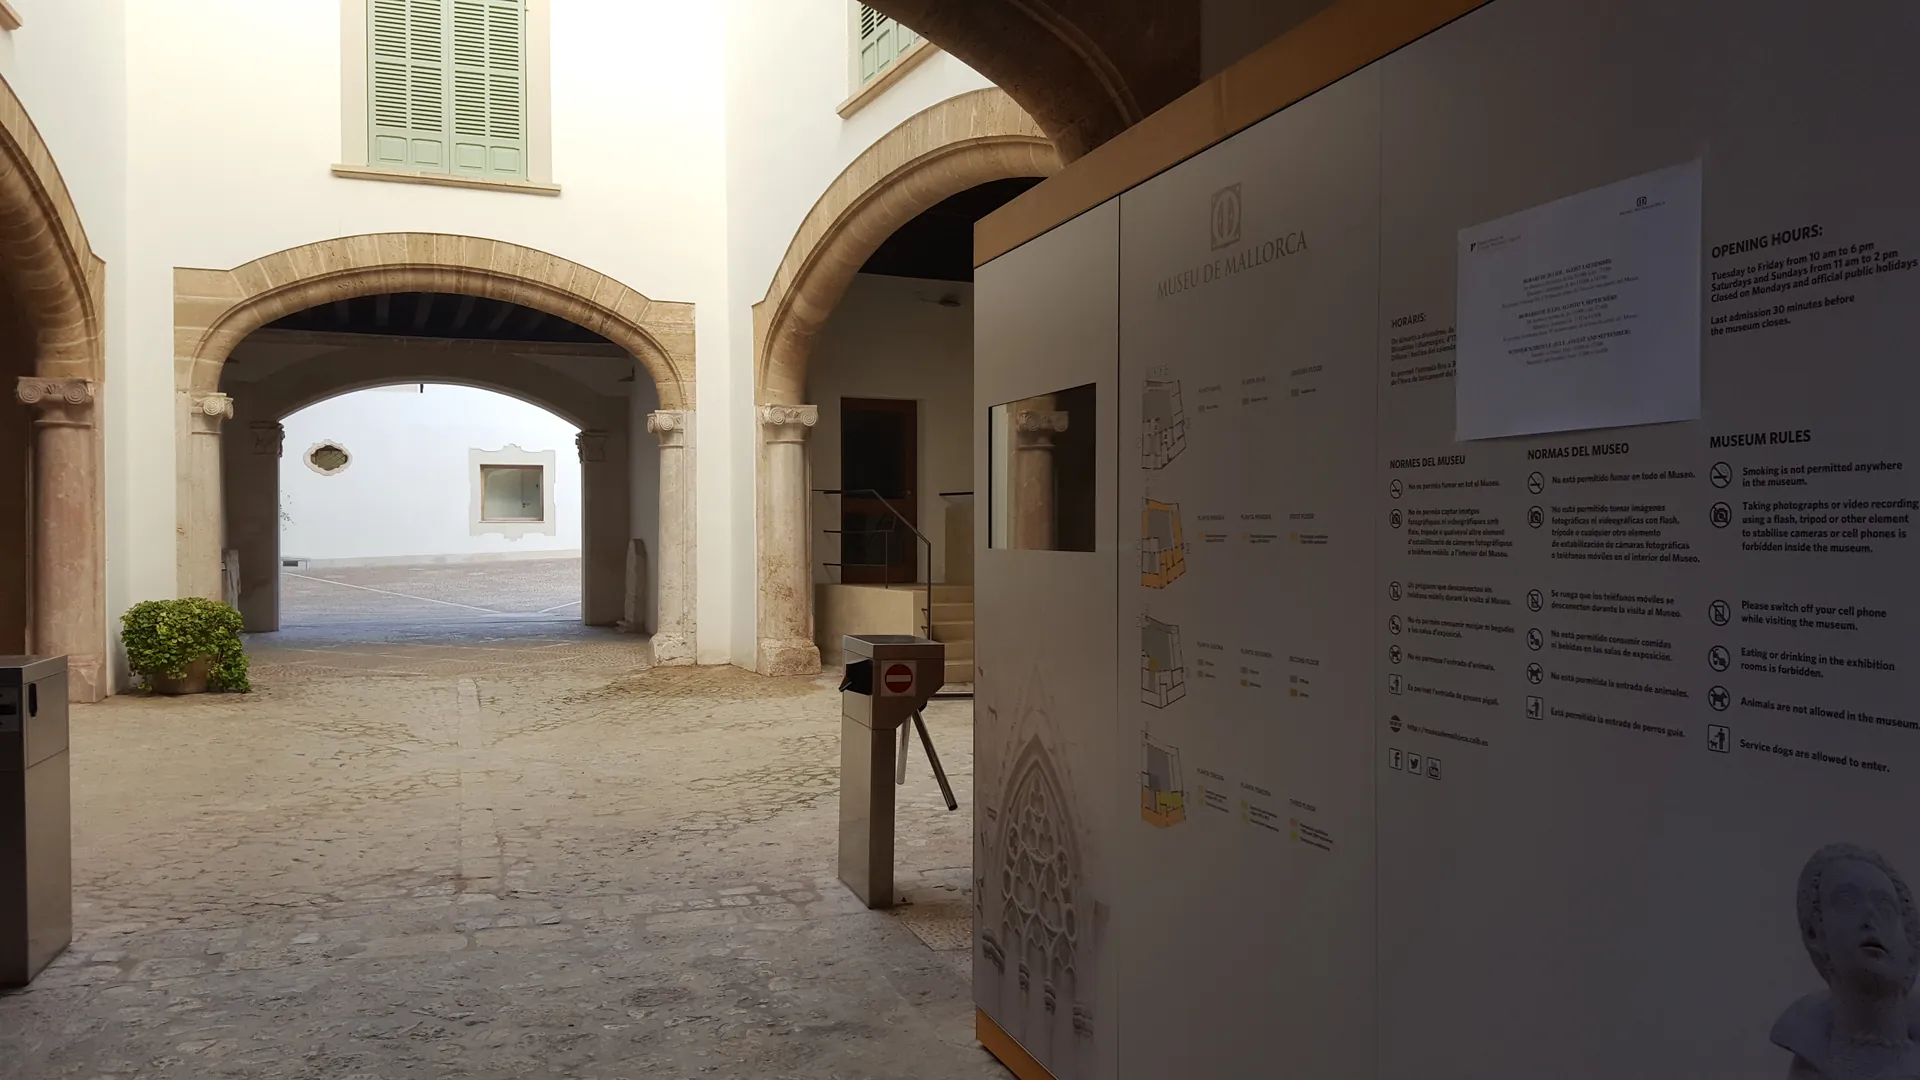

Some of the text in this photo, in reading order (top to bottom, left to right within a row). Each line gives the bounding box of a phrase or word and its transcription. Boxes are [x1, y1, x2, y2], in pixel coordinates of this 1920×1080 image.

[1712, 224, 1823, 258] OPENING HOURS:
[1158, 230, 1307, 300] MUSEU DE MALLORCA
[1711, 242, 1874, 281] Tuesday to Friday from 10 am to 6 pm
[1711, 249, 1898, 292] Saturdays and Sundays from 11 am to 2 pm
[1711, 257, 1918, 303] Closed on Mondays and official public holidays
[1711, 294, 1855, 325] Last admission 30 minutes before
[1711, 318, 1791, 336] the museum closes.
[1710, 429, 1811, 448] MUSEUM RULES
[1527, 442, 1629, 460] NORMAS DEL MUSEO
[1390, 455, 1465, 469] NORMES DEL MUSEU
[1742, 461, 1902, 477] Smoking is not permitted anywhere
[1743, 478, 1808, 487] in the museum.
[1742, 498, 1919, 511] Taking photographs or video recording
[1742, 516, 1765, 525] using
[1774, 515, 1798, 524] flash,
[1800, 515, 1827, 526] tripod
[1841, 515, 1866, 523] other
[1868, 514, 1909, 523] element
[1742, 528, 1907, 540] to stabilise cameras or cell phones is
[1742, 542, 1873, 553] forbidden inside the museum.
[1742, 600, 1887, 619] Please switch off your cell phone
[1741, 615, 1858, 631] while visiting the museum.
[1741, 647, 1895, 671] Eating or drinking in the exhibition
[1741, 662, 1824, 678] rooms is forbidden.
[1741, 697, 1775, 710] Animals
[1777, 702, 1790, 711] are
[1793, 704, 1807, 714] not
[1809, 706, 1845, 720] allowed
[1847, 711, 1856, 720] in
[1858, 712, 1873, 723] the
[1740, 739, 1890, 772] Service dogs are allowed to enter.
